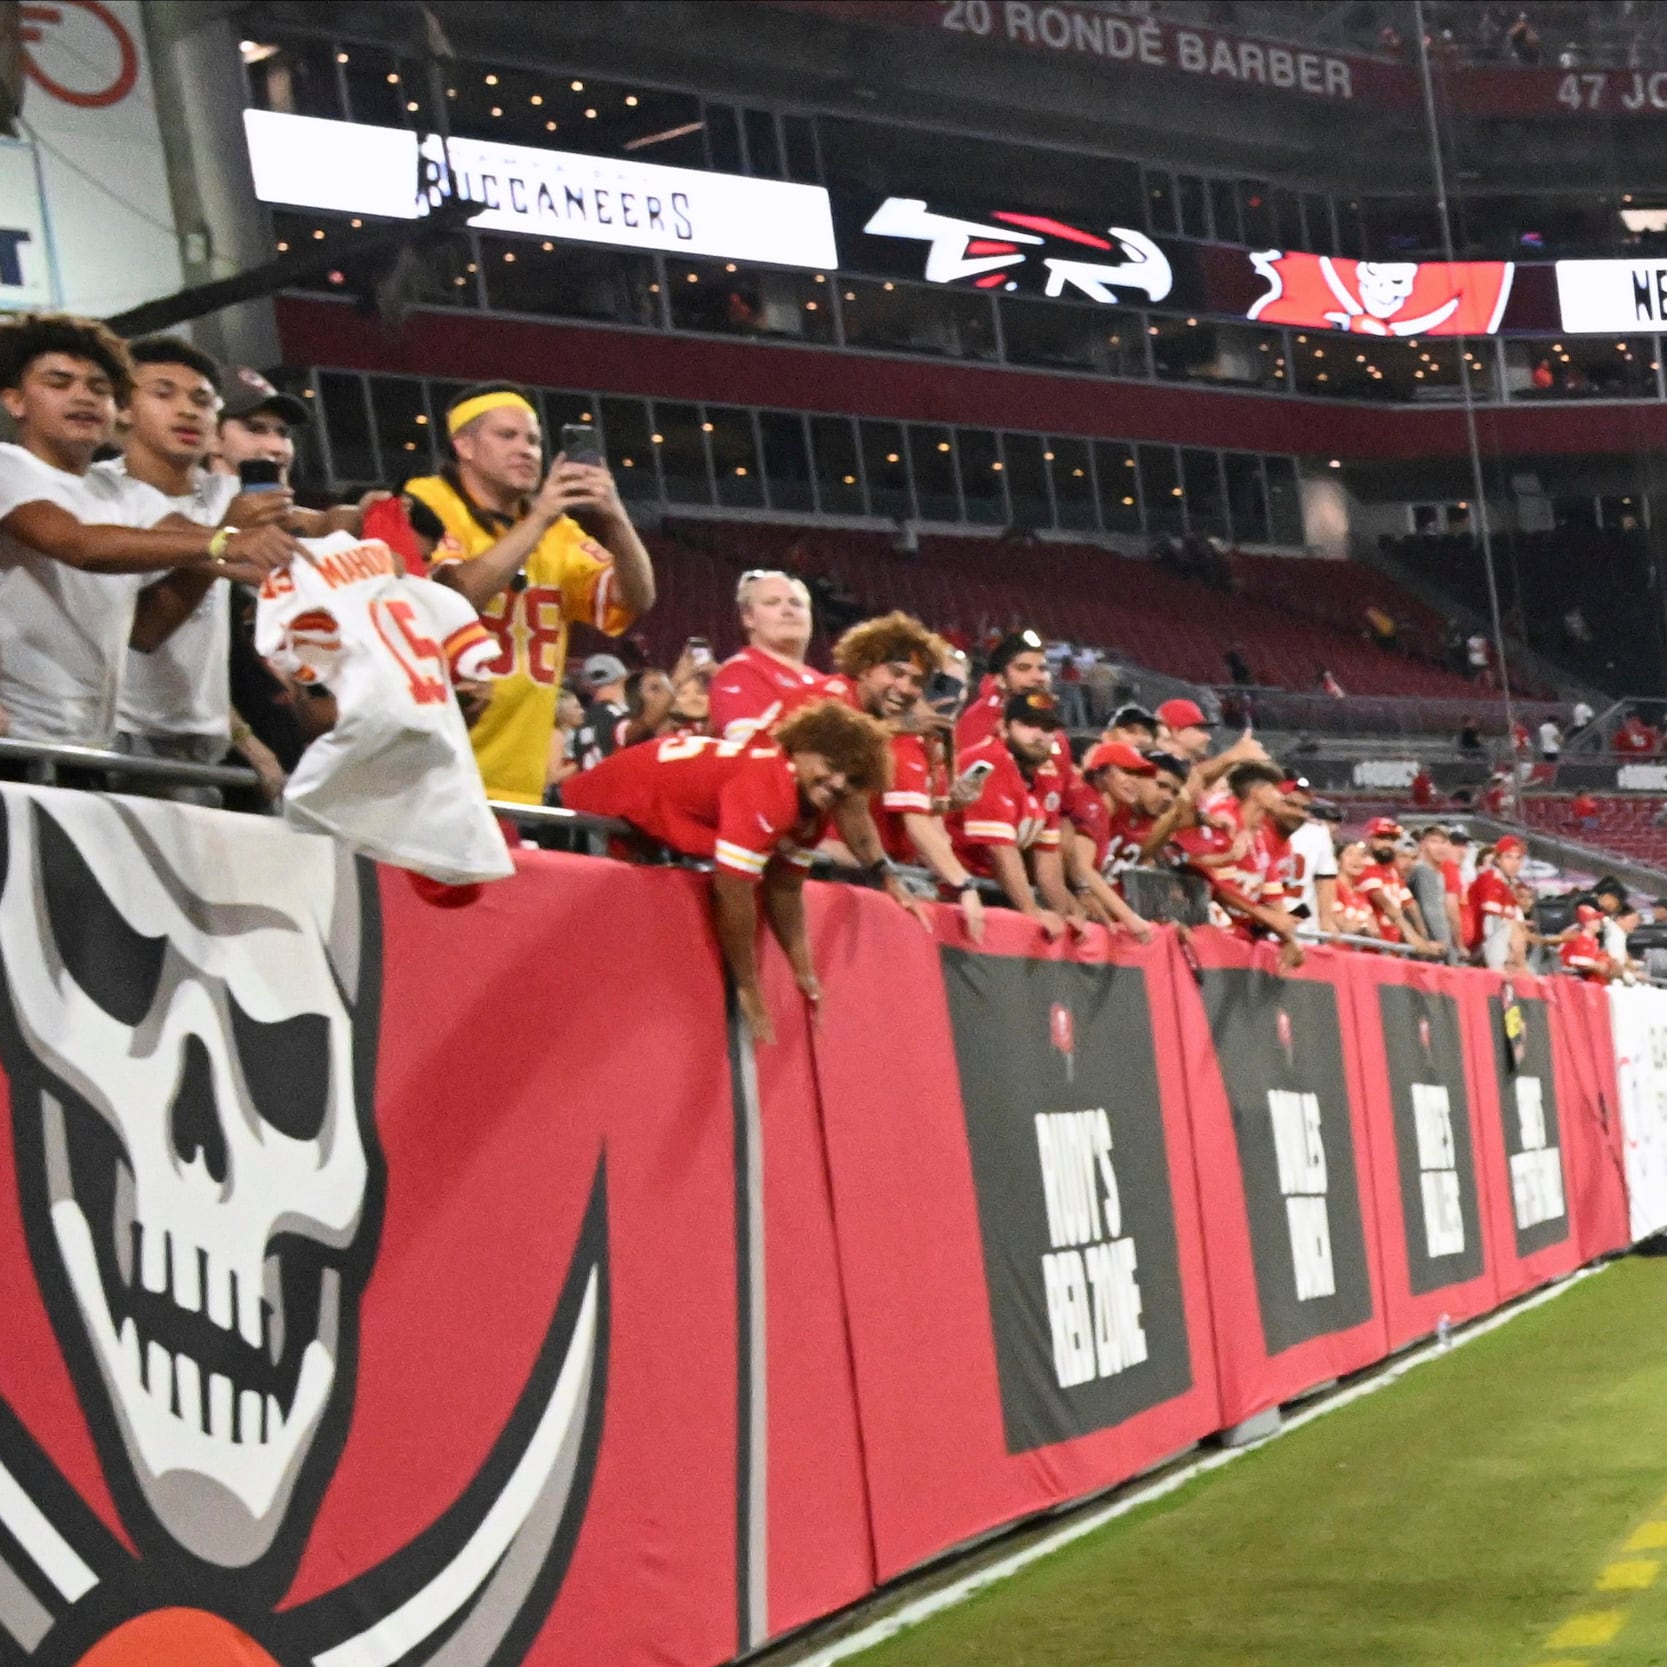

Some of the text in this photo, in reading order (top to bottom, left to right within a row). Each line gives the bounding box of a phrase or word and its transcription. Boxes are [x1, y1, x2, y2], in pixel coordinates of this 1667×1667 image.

[942, 1, 993, 35] 20
[1176, 31, 1353, 98] BARBER
[1556, 72, 1606, 110] 47
